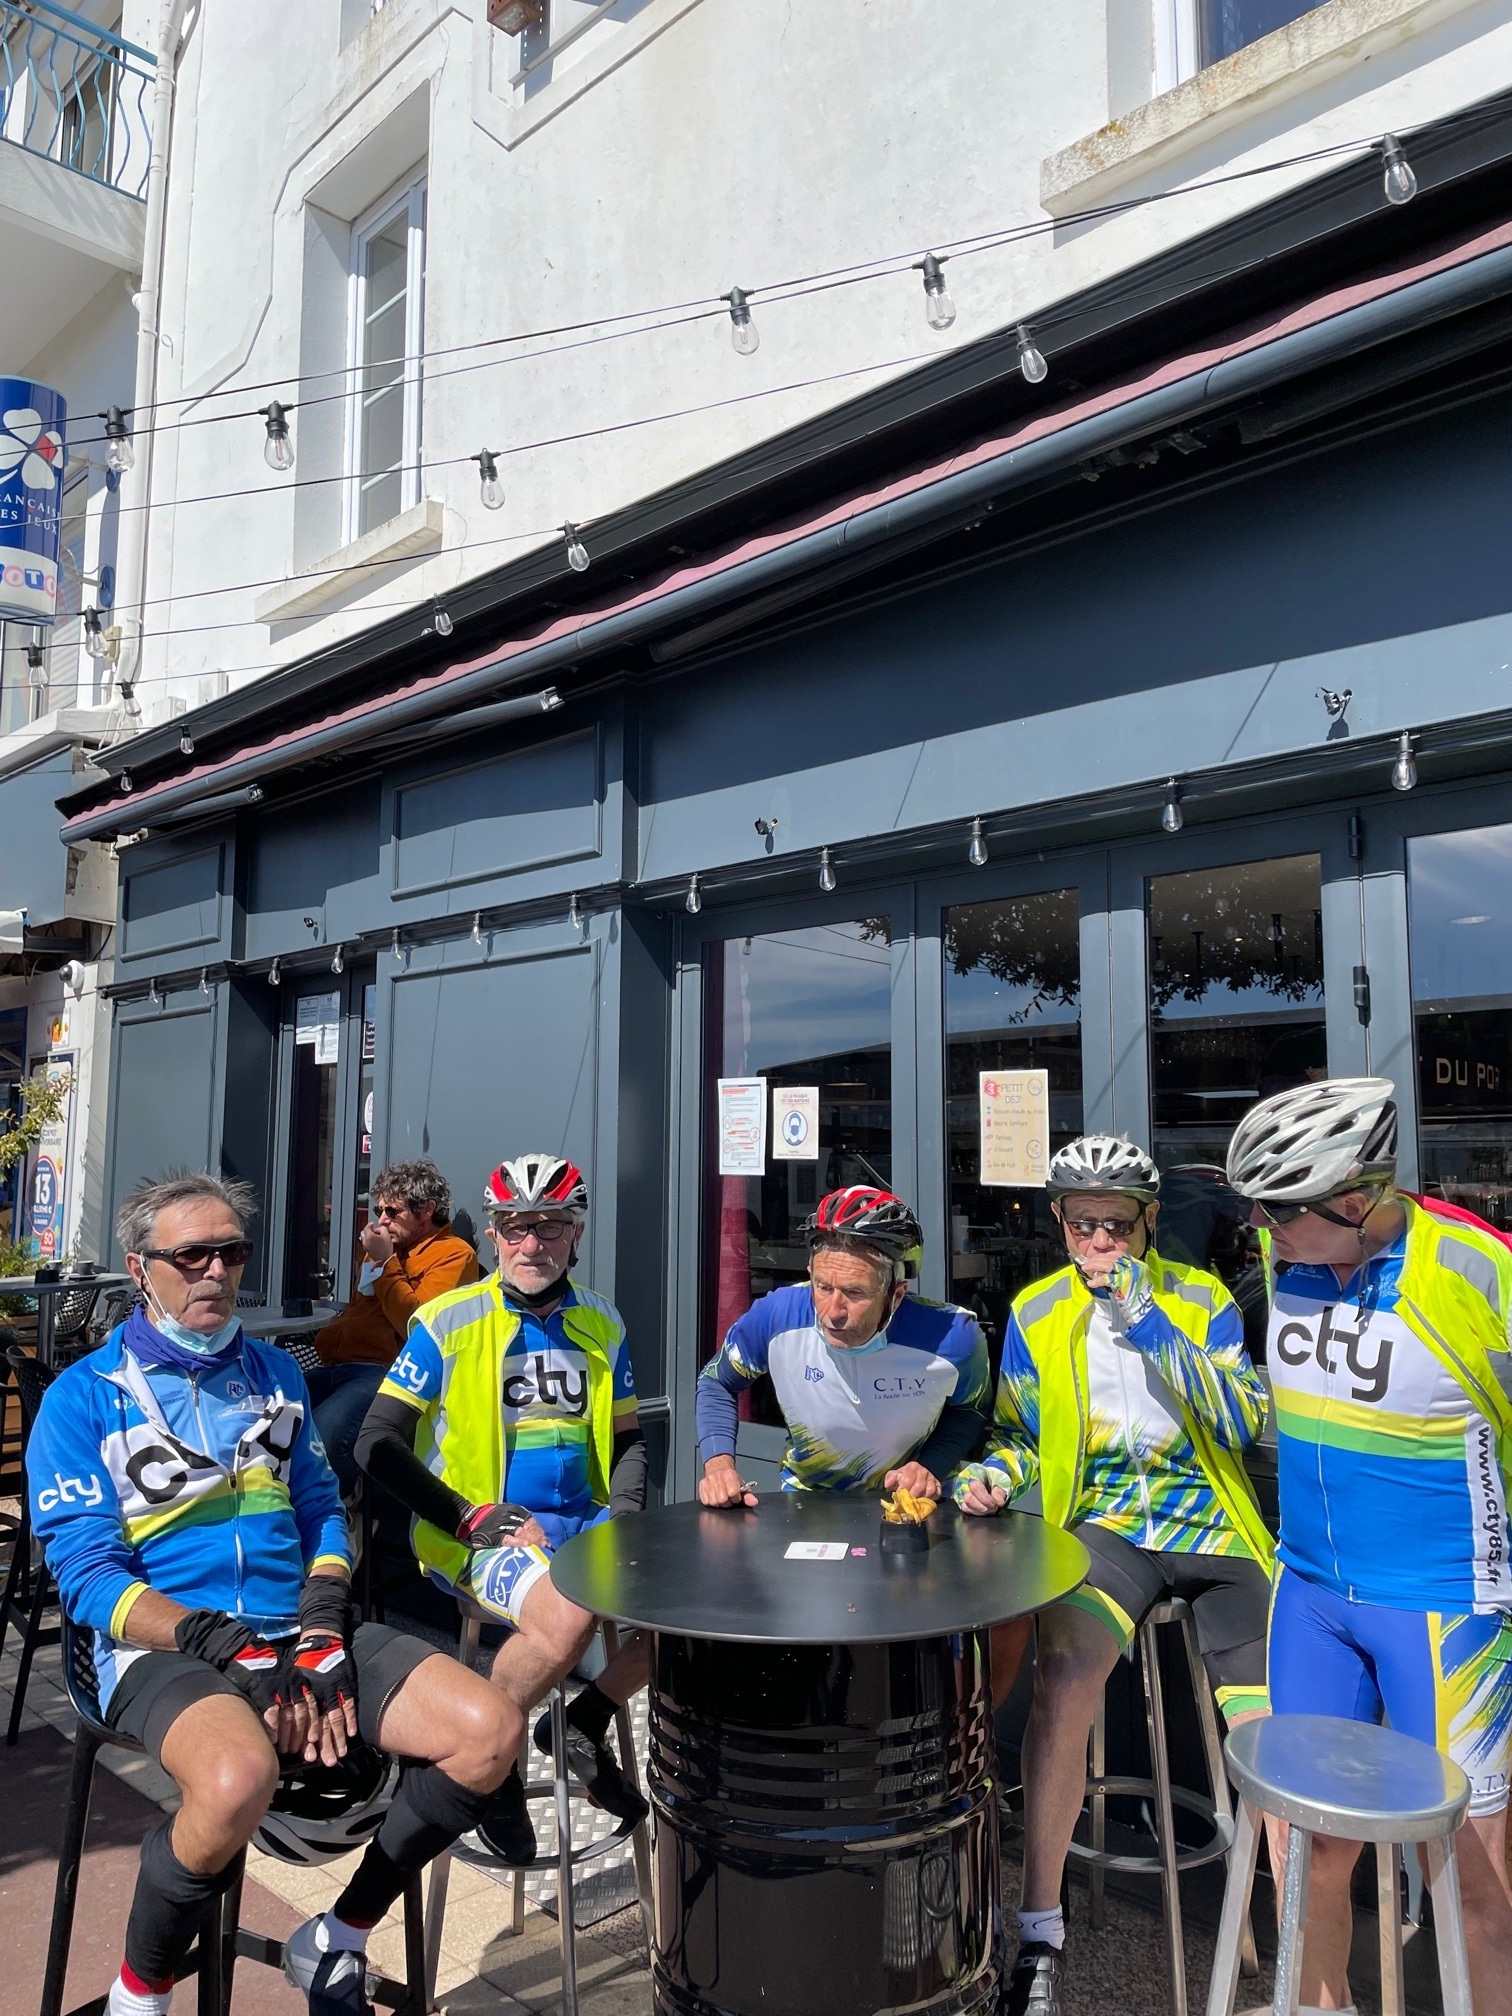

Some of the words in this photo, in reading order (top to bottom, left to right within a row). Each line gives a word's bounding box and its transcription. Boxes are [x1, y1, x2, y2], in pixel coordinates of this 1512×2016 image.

[27, 514, 57, 535] JEUX
[0, 563, 56, 598] OTO
[1000, 1083, 1024, 1093] PETIT
[1436, 1057, 1468, 1086] DU
[34, 1173, 52, 1205] 13
[1277, 1306, 1394, 1403] cty
[390, 1351, 430, 1394] cty
[502, 1355, 587, 1417] cty
[873, 1377, 926, 1392] C.T.Y
[38, 1473, 103, 1512] cty
[1477, 1426, 1503, 1586] www.cty85.fr
